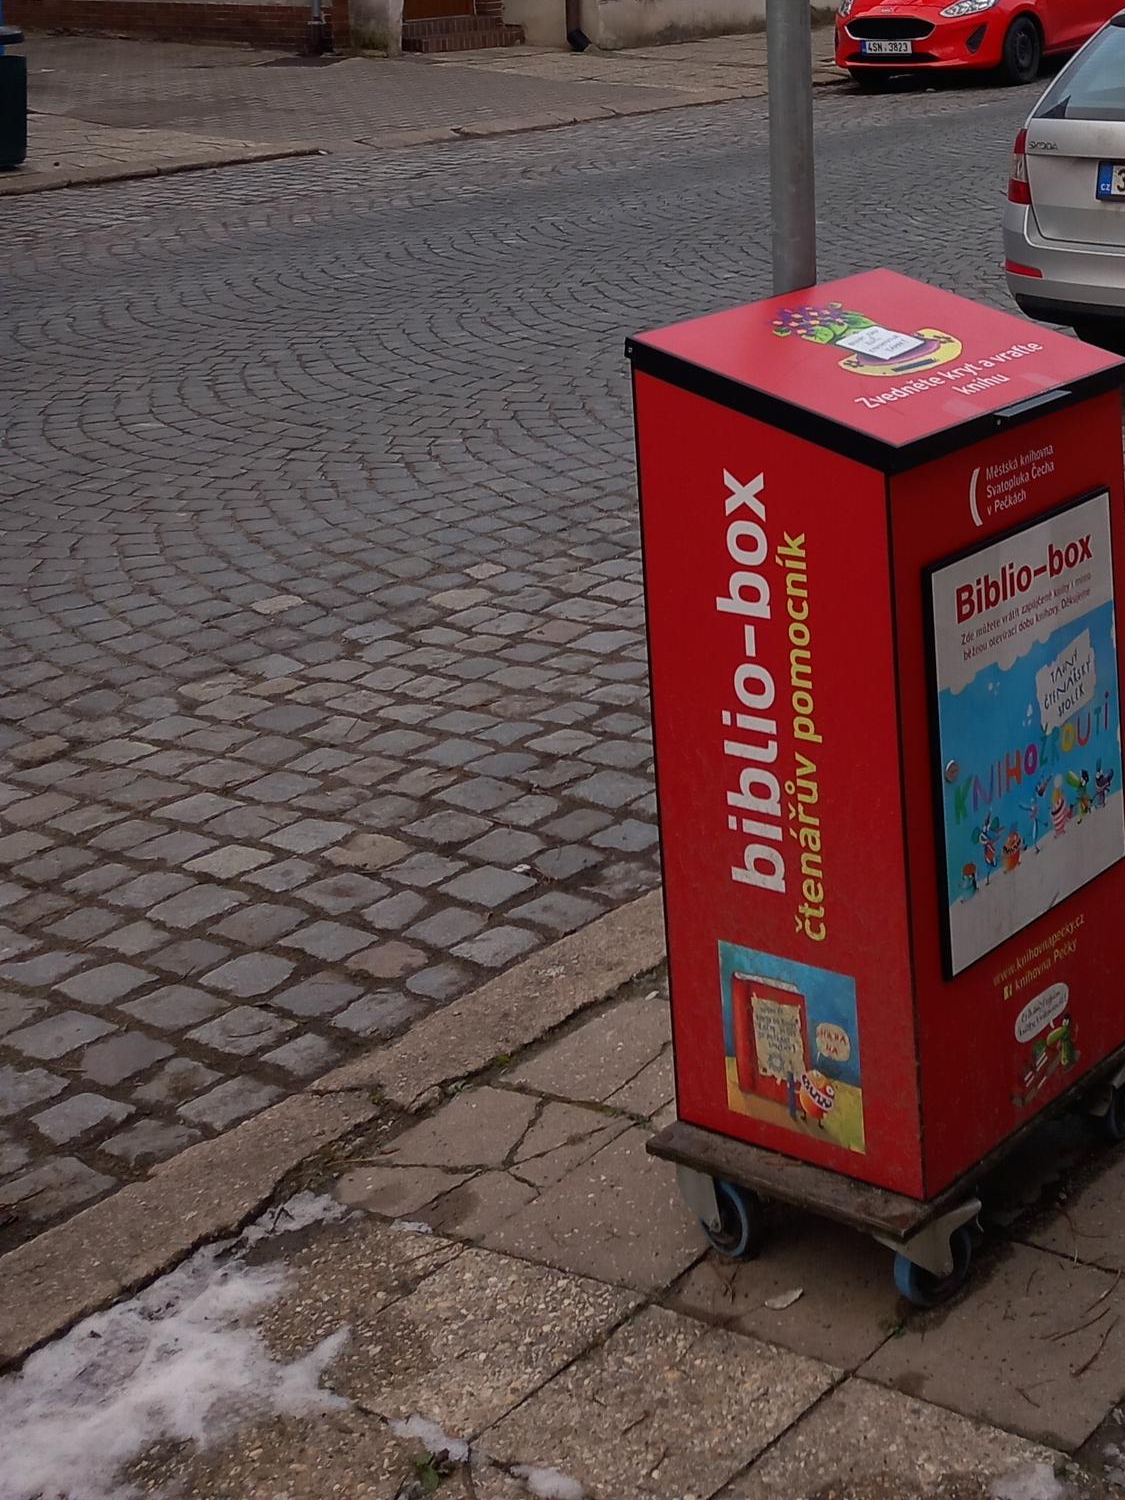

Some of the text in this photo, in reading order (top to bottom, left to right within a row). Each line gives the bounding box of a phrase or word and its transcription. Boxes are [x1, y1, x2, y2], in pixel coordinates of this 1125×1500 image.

[1100, 183, 1112, 192] CZ
[854, 340, 1044, 410] Zvedněte kryt a vraťte
[951, 372, 1011, 396] knihu
[985, 444, 1055, 481] Městská knihovna
[986, 461, 1055, 499] Svatopluka Čecha
[986, 488, 1027, 516] v Pečkách
[955, 533, 1093, 625] Biblio-box
[715, 466, 789, 896] biblio-box
[774, 531, 827, 943] čtenářův pomocník
